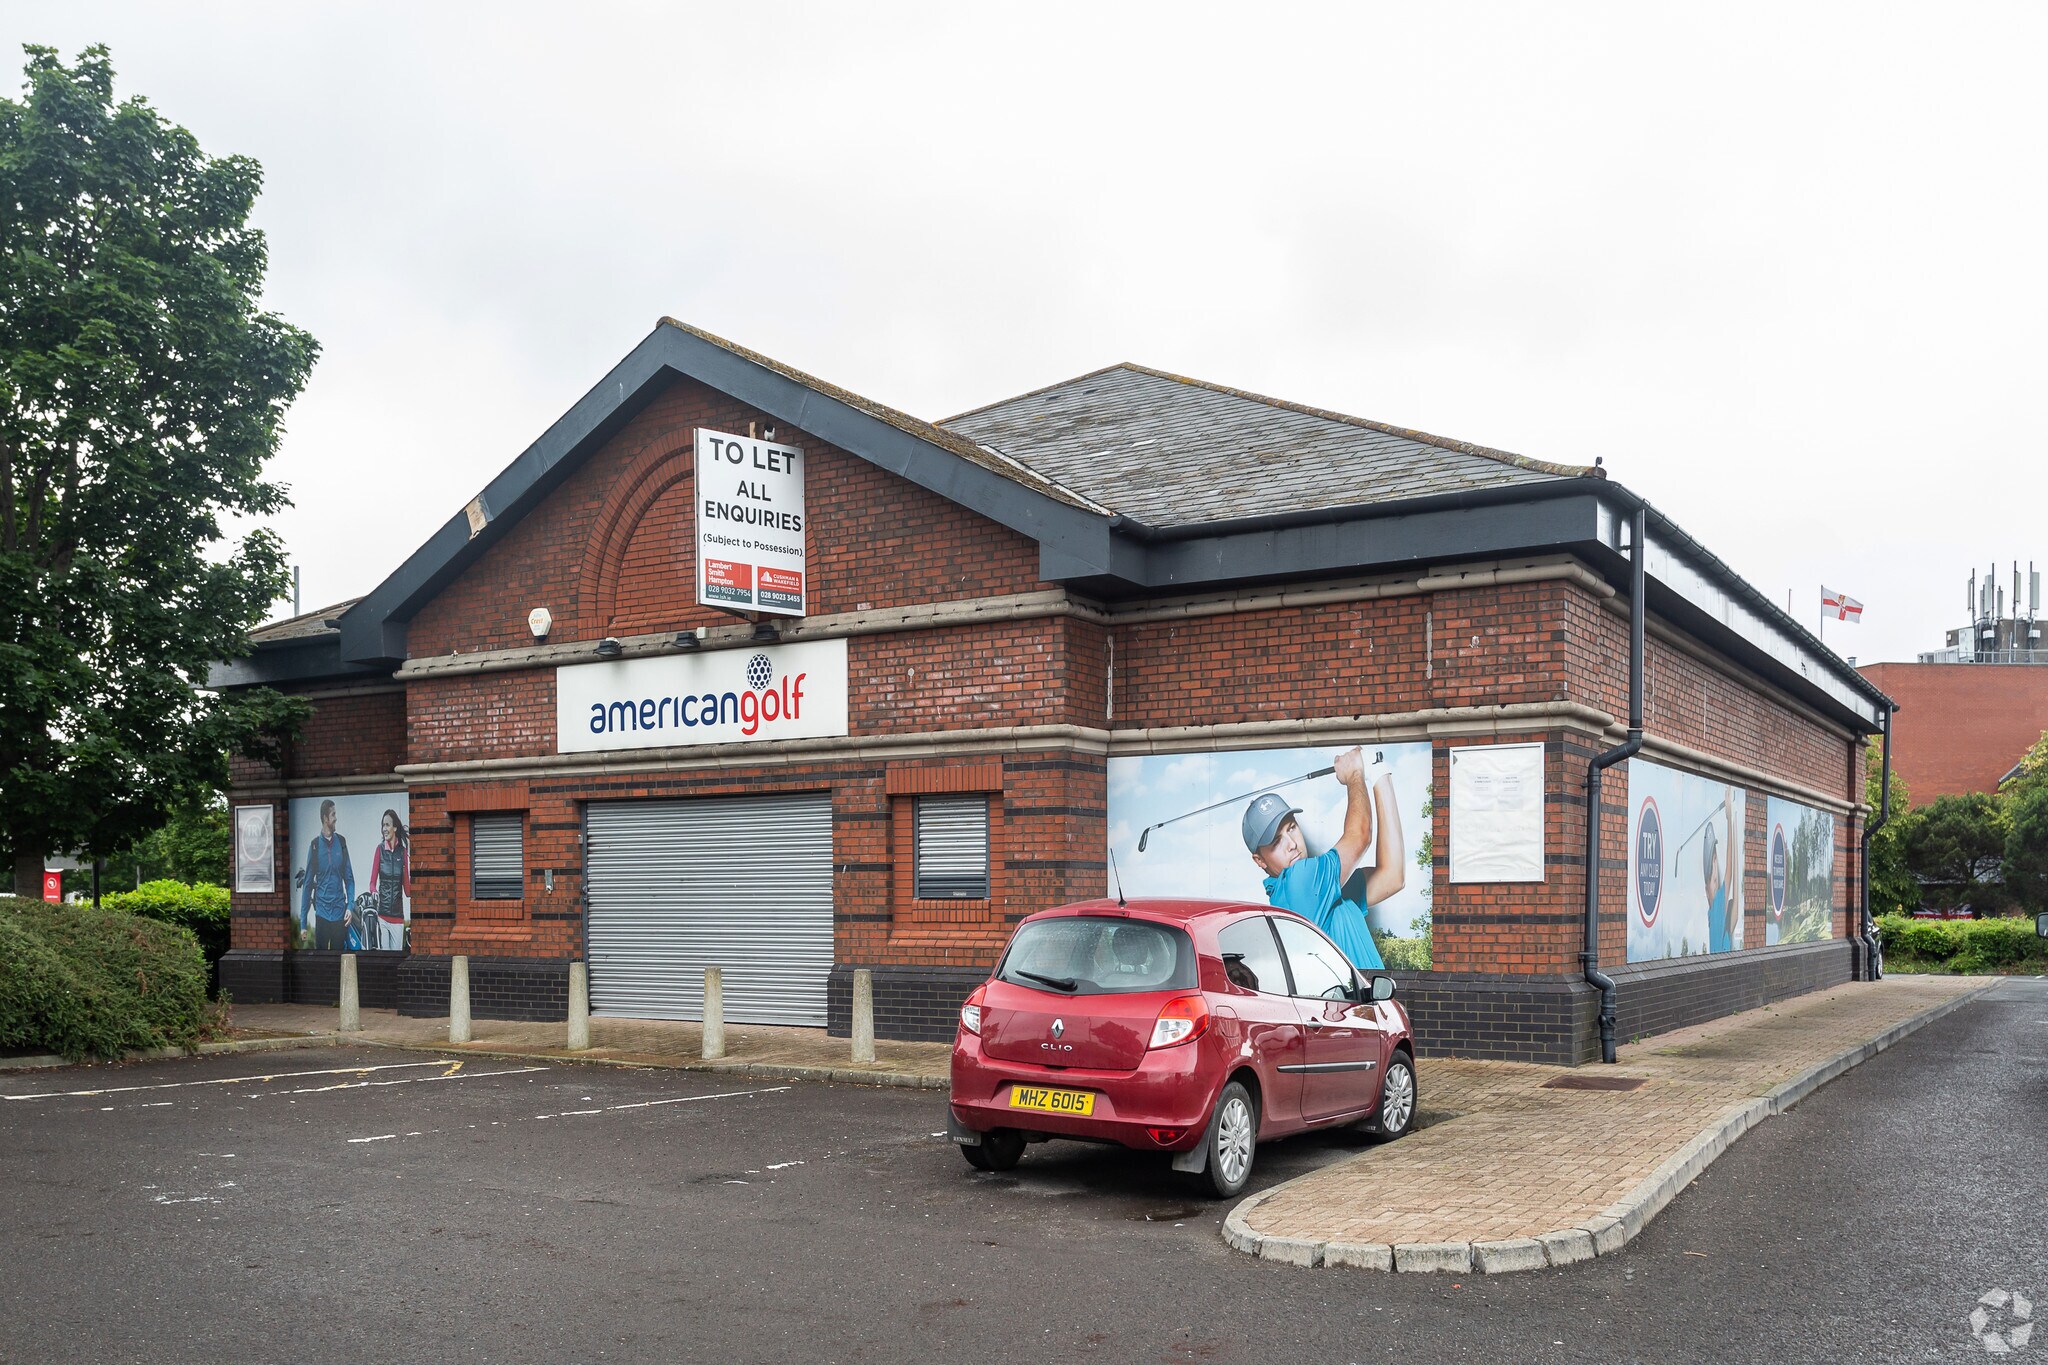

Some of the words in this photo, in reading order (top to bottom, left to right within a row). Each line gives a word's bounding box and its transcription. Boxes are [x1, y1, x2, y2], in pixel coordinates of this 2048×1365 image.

[709, 437, 744, 464] TO
[753, 446, 795, 474] LET
[736, 480, 771, 501] ALL
[705, 500, 801, 532] ENQUIRIES
[703, 533, 740, 546] (Subject
[742, 539, 752, 548] to
[754, 541, 803, 557] Possession)
[708, 560, 732, 570] Lambert
[708, 568, 725, 577] Smith
[708, 576, 734, 586] Hampton
[773, 579, 800, 587] WAKEFIELD
[708, 585, 720, 593] 028
[720, 586, 736, 595] 9032
[760, 591, 771, 599] 028
[772, 592, 786, 601] 9023
[786, 594, 801, 603] 3455
[590, 673, 807, 736] americangolf
[247, 824, 264, 837] TRY
[1642, 832, 1657, 860] TRY
[1041, 1043, 1072, 1051] CLIO
[1019, 1089, 1048, 1107] MHZ
[1051, 1092, 1086, 1110] 6015
